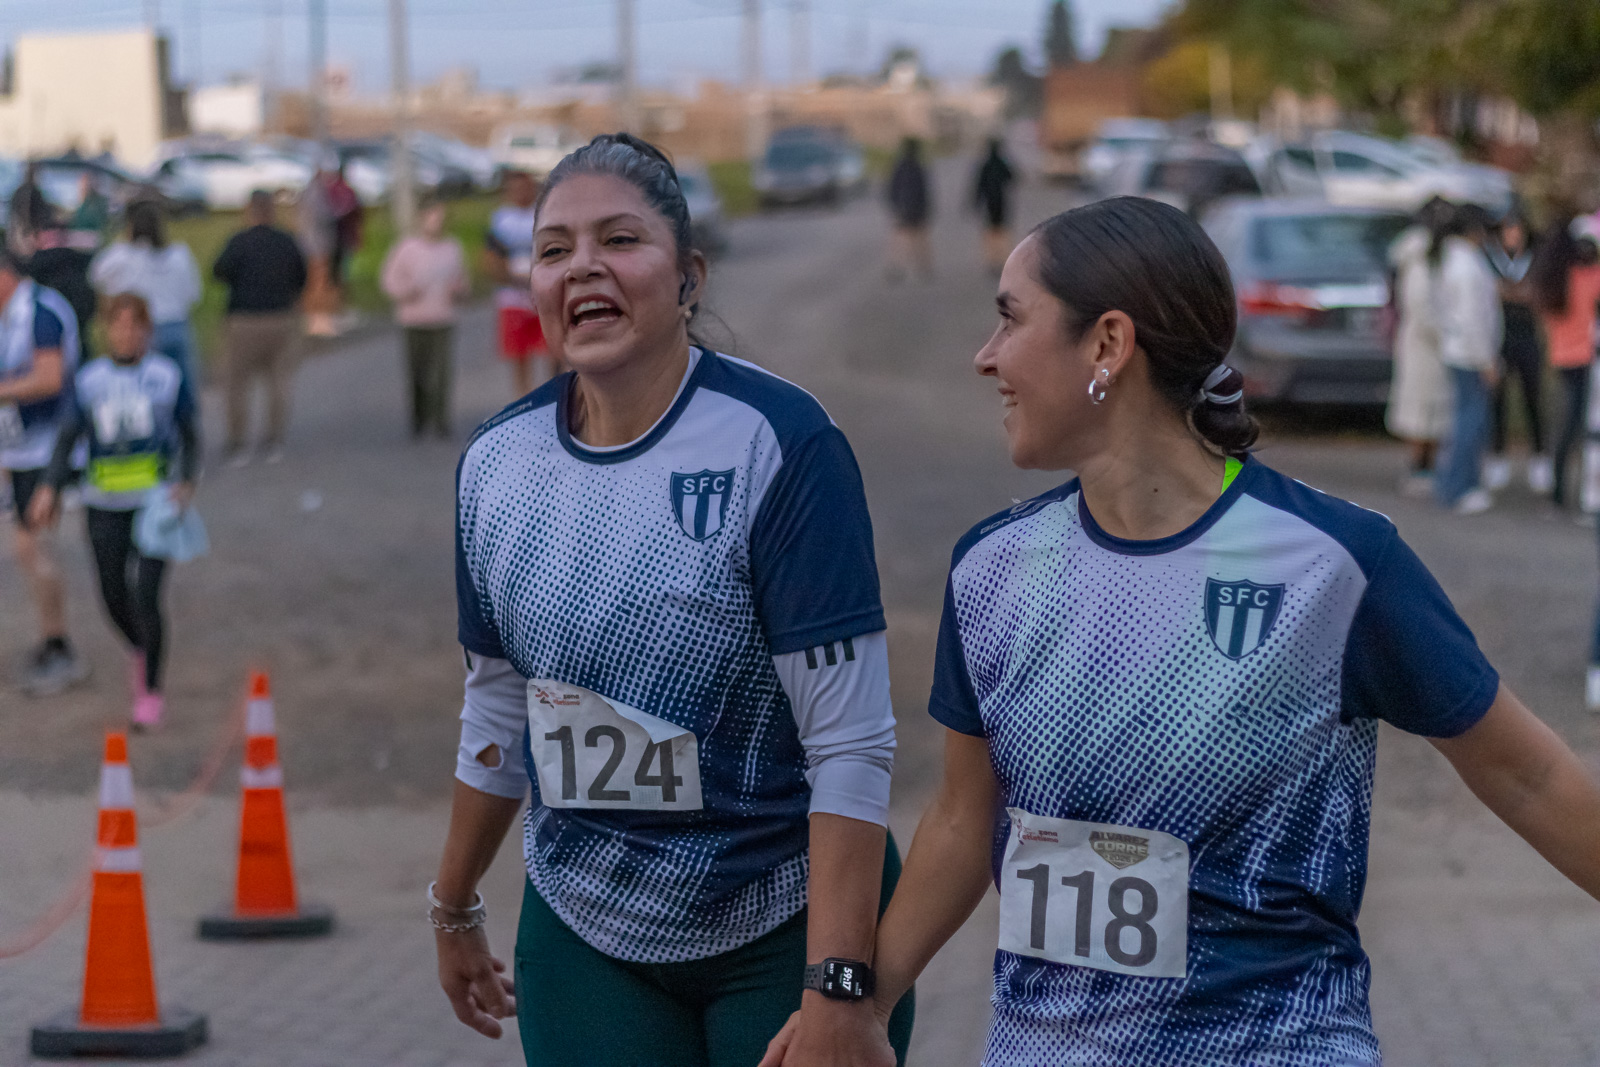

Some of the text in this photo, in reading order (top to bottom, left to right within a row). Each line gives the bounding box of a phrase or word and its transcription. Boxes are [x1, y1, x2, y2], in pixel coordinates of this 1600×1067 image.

[682, 475, 727, 494] SFC
[1217, 585, 1270, 607] SFC
[544, 724, 683, 803] 124
[1093, 840, 1148, 857] CORRE
[1016, 863, 1159, 968] 118
[842, 966, 853, 991] 59:17
